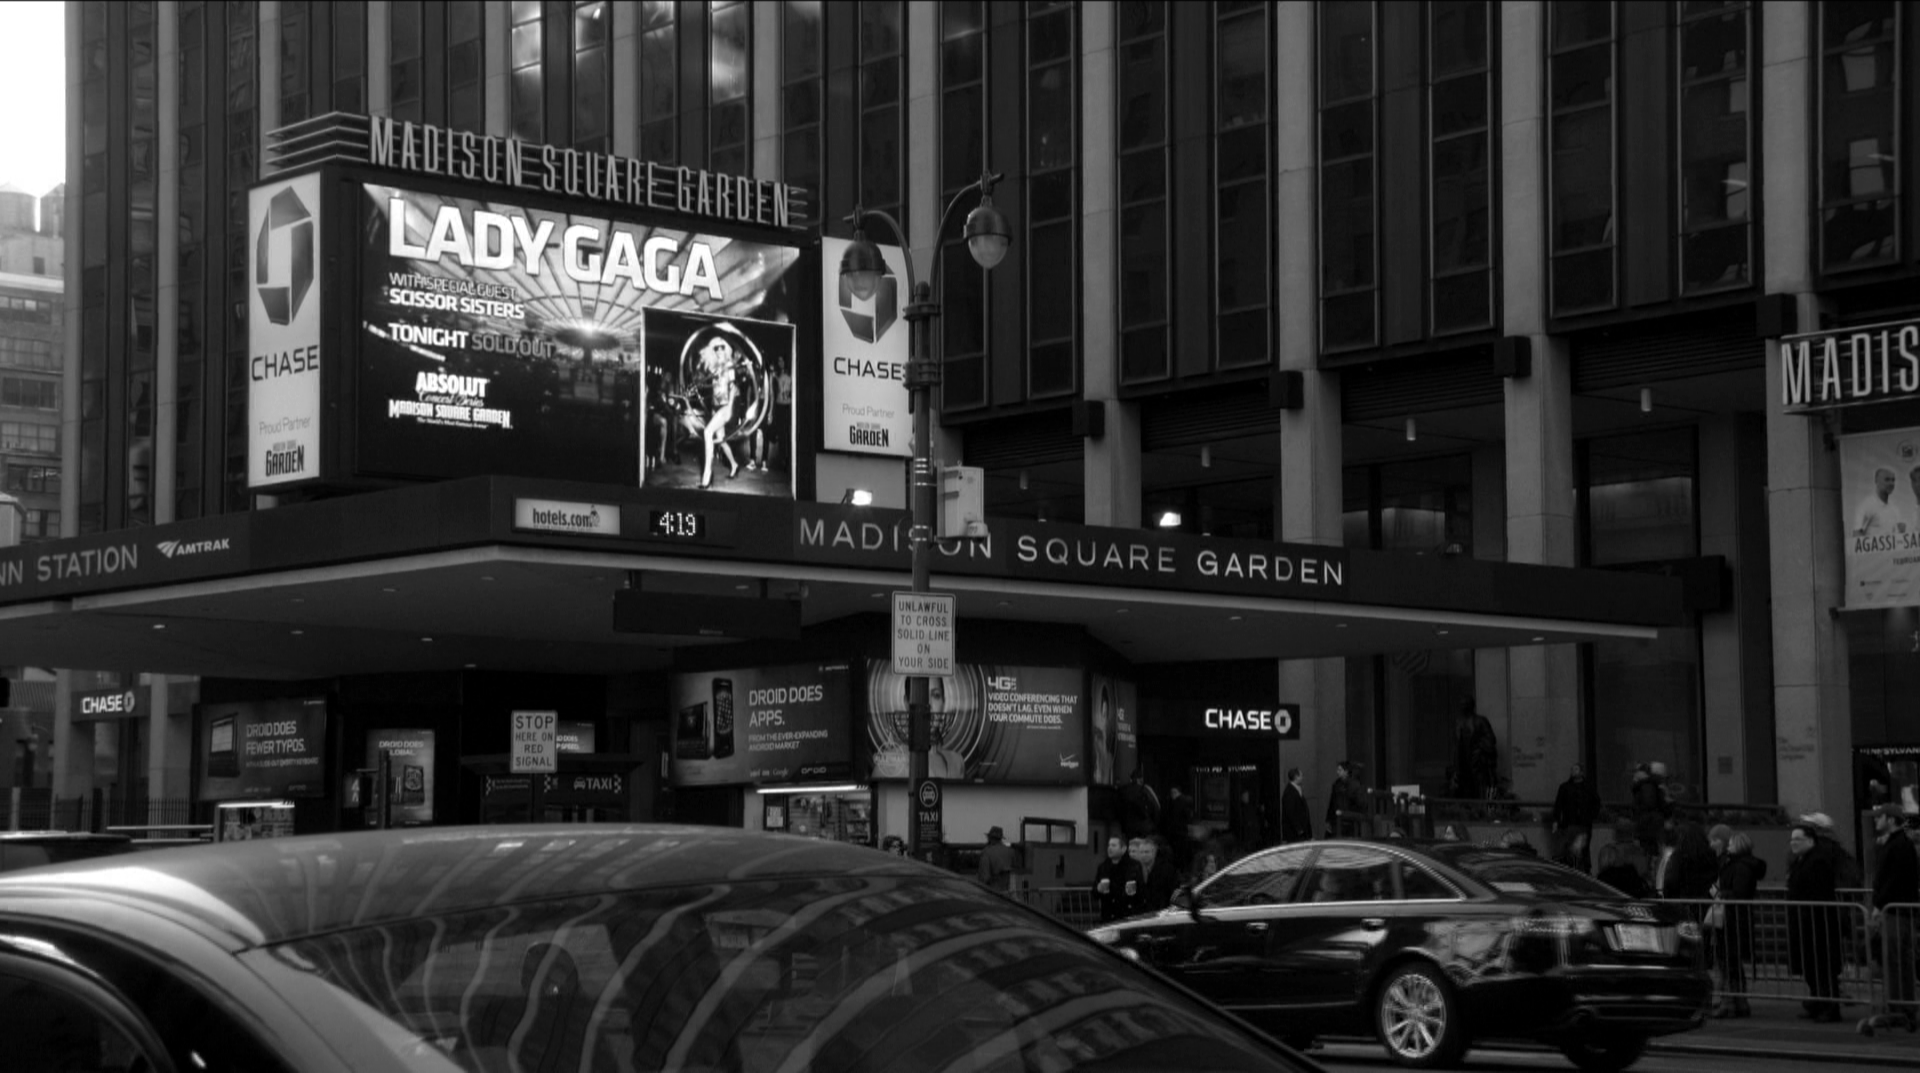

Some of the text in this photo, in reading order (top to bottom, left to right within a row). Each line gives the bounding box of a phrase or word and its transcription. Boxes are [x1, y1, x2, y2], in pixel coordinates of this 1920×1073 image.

[370, 114, 788, 227] MADISON SQUARE GARDEN
[389, 196, 724, 300] LADY GAGA
[389, 272, 517, 300] WITH SPECIAL GUEST
[389, 288, 526, 320] SCISSOR SISTERS
[388, 323, 555, 358] TONIGHT SOLD OUT
[251, 344, 319, 382] CHASE
[833, 356, 903, 381] CHASE
[1781, 325, 1920, 406] MADIS
[415, 371, 489, 398] ABSOLUT
[842, 403, 895, 419] Proud Partner
[258, 416, 311, 435] Proud Partner
[849, 425, 889, 448] GARDEN
[265, 445, 304, 477] GARDEN
[533, 507, 592, 528] hotels.com
[659, 511, 696, 537] 4:19
[176, 538, 230, 556] AMTRAK
[37, 543, 138, 582] STATION
[1017, 534, 1176, 573] SQUARE
[1197, 549, 1342, 586] GARDEN
[898, 601, 948, 614] UNLAWFUL
[901, 614, 947, 627] TO CROSS
[897, 628, 950, 642] SOLID LINE
[917, 643, 930, 654] ON
[898, 656, 949, 669] YOUR SIDE
[80, 693, 123, 715] CHASE
[749, 685, 823, 706] DROID DOES
[988, 692, 1078, 705] VIDEO CONFERENCING THAT
[988, 702, 1017, 712] DOESN'T
[1033, 704, 1052, 714] EVEN
[1052, 705, 1072, 715] WHEN
[988, 712, 1008, 722] YOUR
[1008, 713, 1042, 723] COMMUTE
[515, 715, 554, 730] STOP
[749, 710, 785, 727] APPS.
[1204, 708, 1272, 731] CHASE
[246, 720, 297, 737] DROID DOES
[515, 732, 537, 742] HERE
[542, 732, 554, 742] ON
[246, 740, 275, 756] FEWER
[524, 744, 543, 753] RED
[515, 756, 552, 767] SIGNAL
[586, 777, 613, 791] TAXI
[918, 810, 939, 823] TAXI
